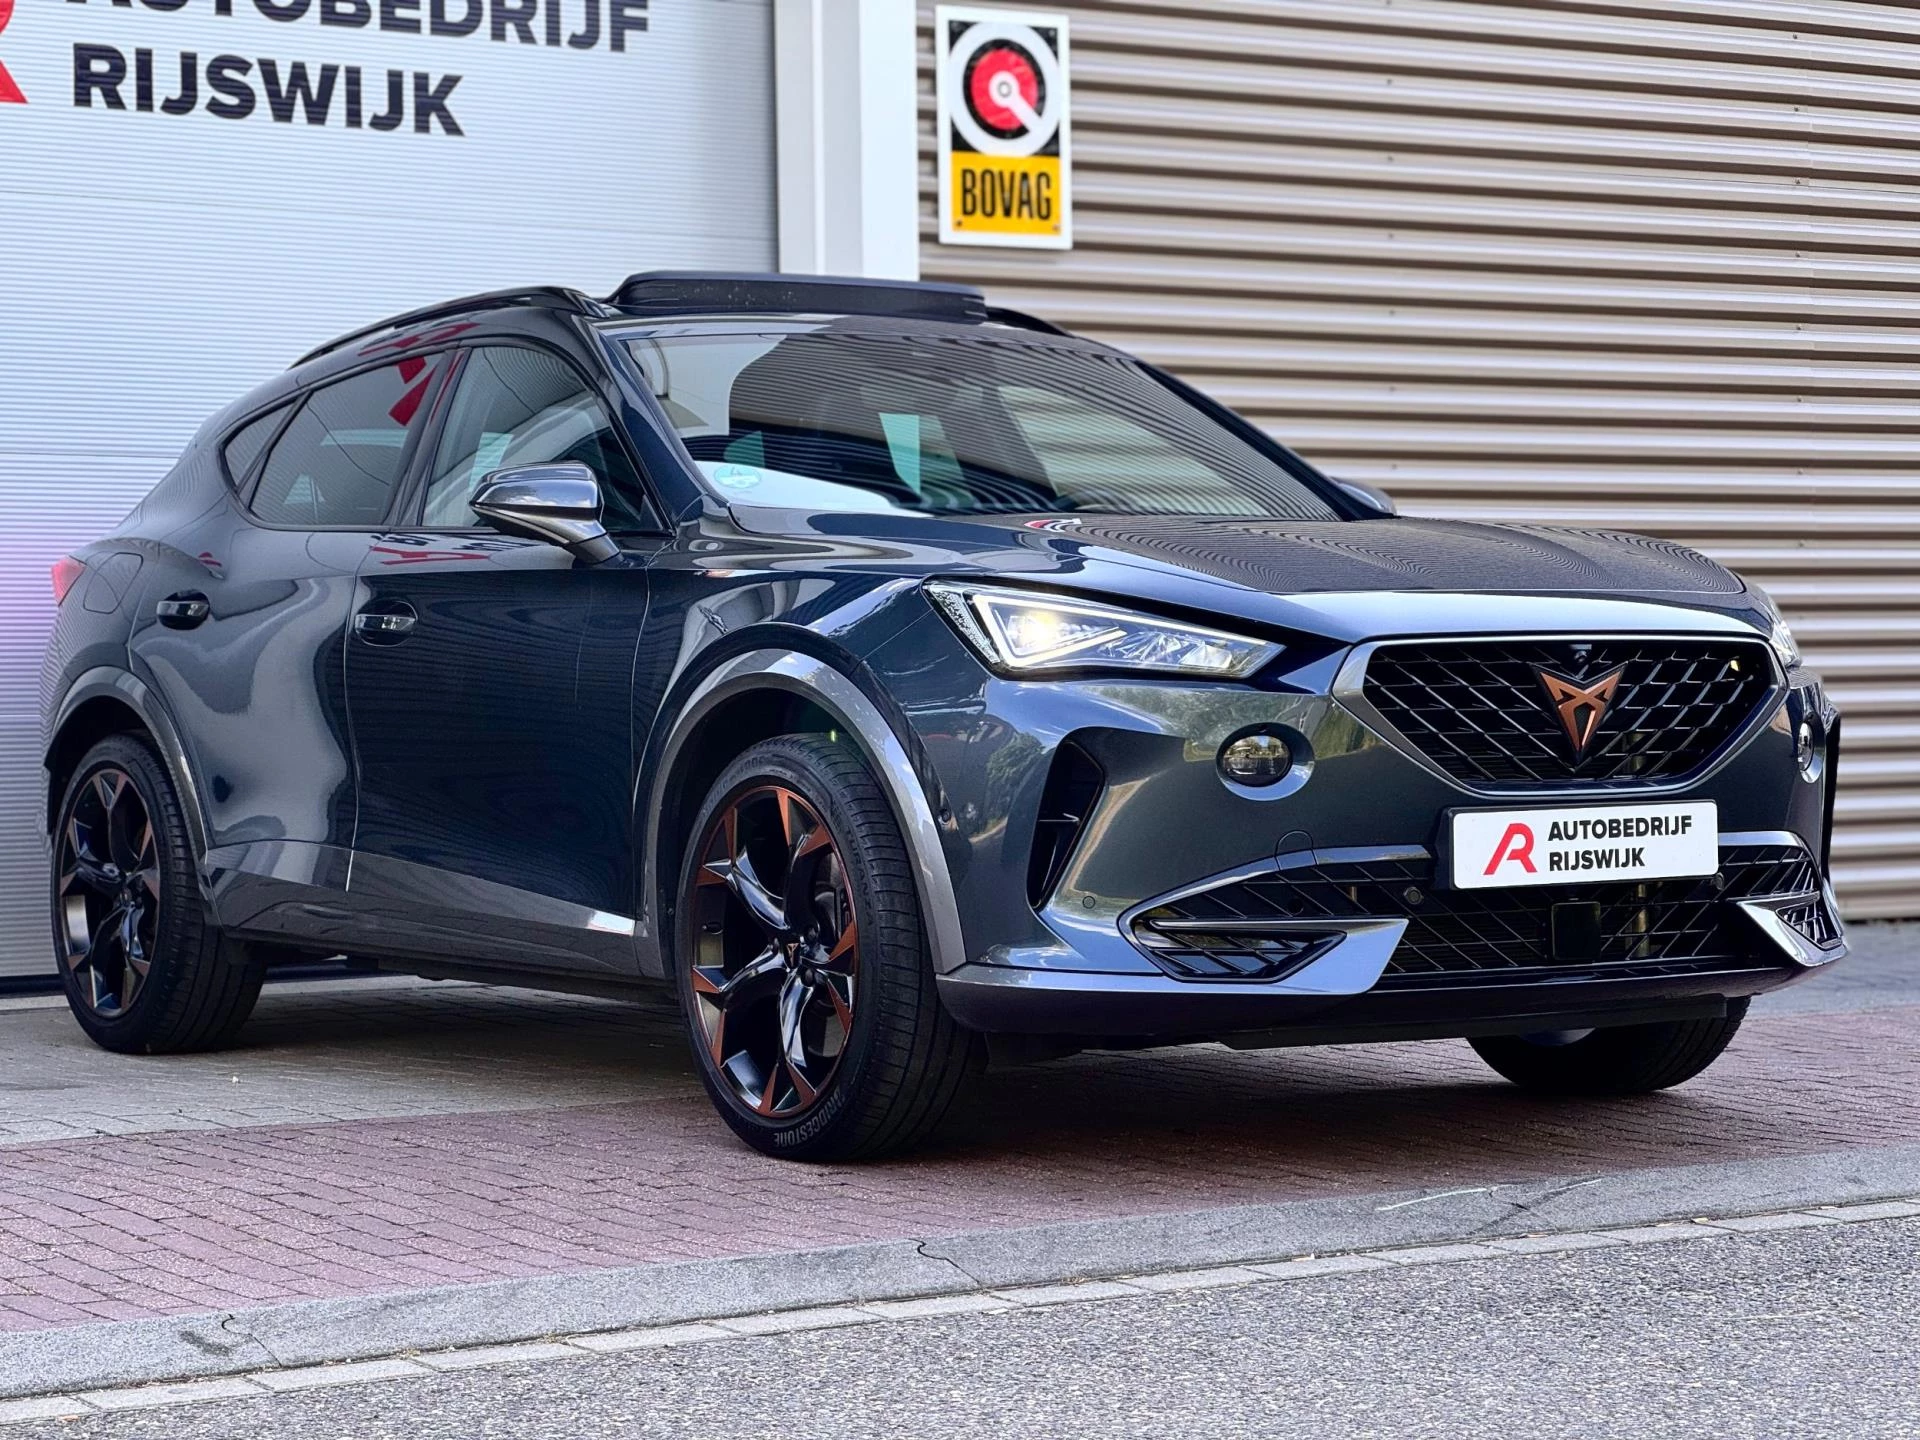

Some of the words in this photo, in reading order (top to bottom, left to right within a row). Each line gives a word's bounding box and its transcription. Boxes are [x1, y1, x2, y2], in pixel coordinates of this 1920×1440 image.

[66, 0, 649, 53] EDRIJF
[73, 42, 465, 137] RIJSWIJK
[961, 168, 1052, 220] BOVAG
[1548, 815, 1693, 841] AUTOBEDRIJF
[1549, 848, 1646, 872] RIJSWIJK
[773, 1085, 846, 1148] BRIDGESTONE
